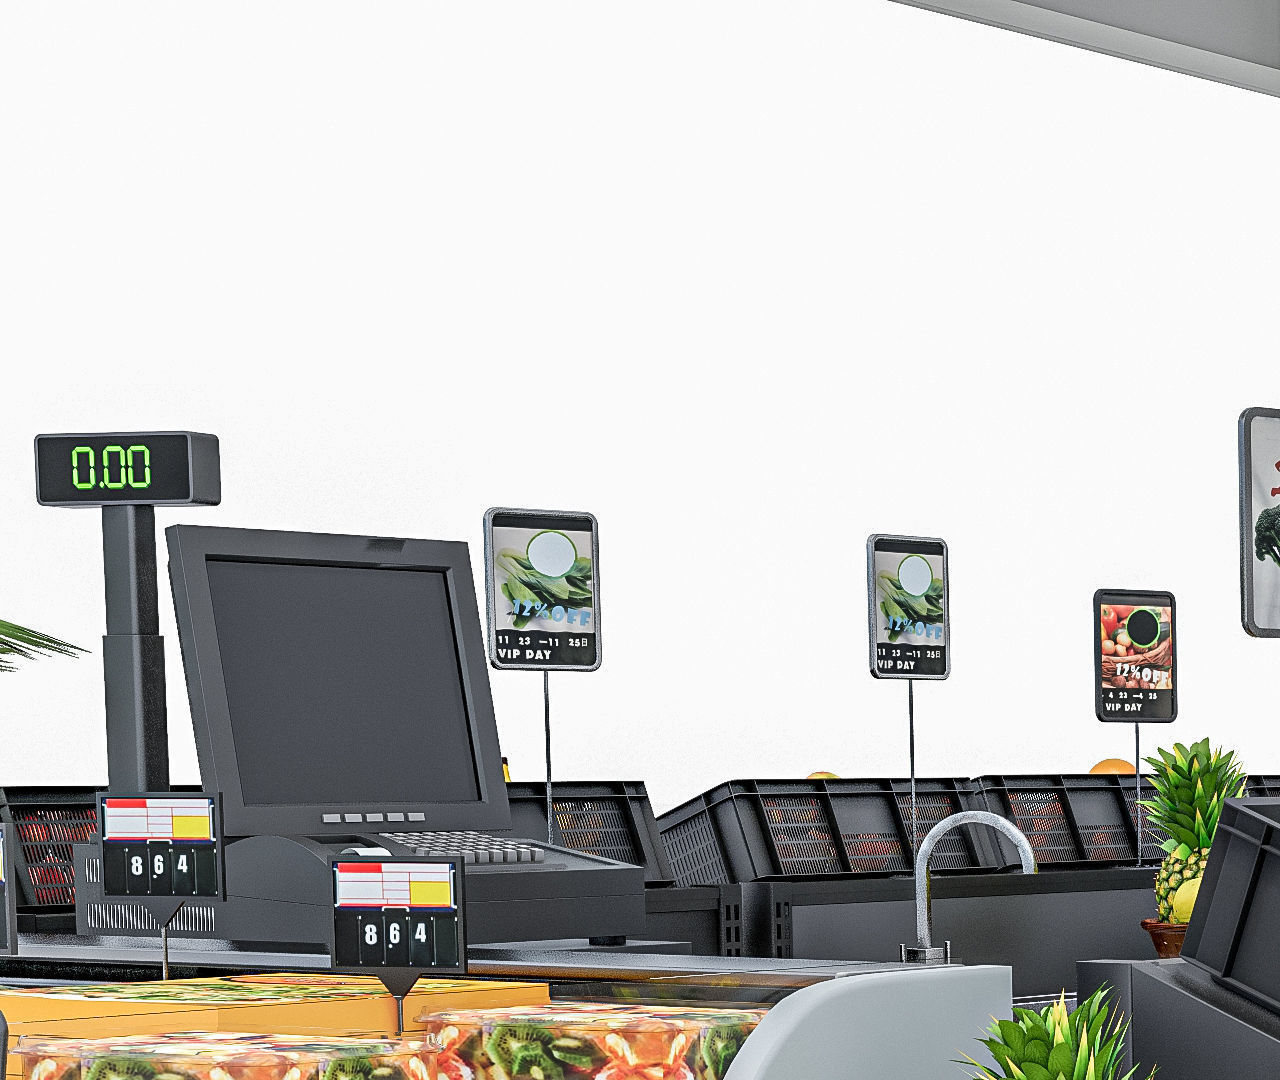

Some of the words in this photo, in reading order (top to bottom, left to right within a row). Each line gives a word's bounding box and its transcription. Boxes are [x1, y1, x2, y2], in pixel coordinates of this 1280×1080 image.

[71, 445, 151, 490] 0.00
[513, 599, 592, 626] 12%OFF
[888, 616, 943, 640] 12%OFF
[498, 636, 509, 644] 11
[518, 637, 531, 645] 23
[498, 649, 521, 659] VIP
[526, 649, 552, 660] DAY
[878, 660, 894, 669] VIP
[897, 660, 915, 670] DAY
[1116, 663, 1168, 685] 12%OFF
[1105, 703, 1122, 711] VIP
[1124, 703, 1142, 711] DAY
